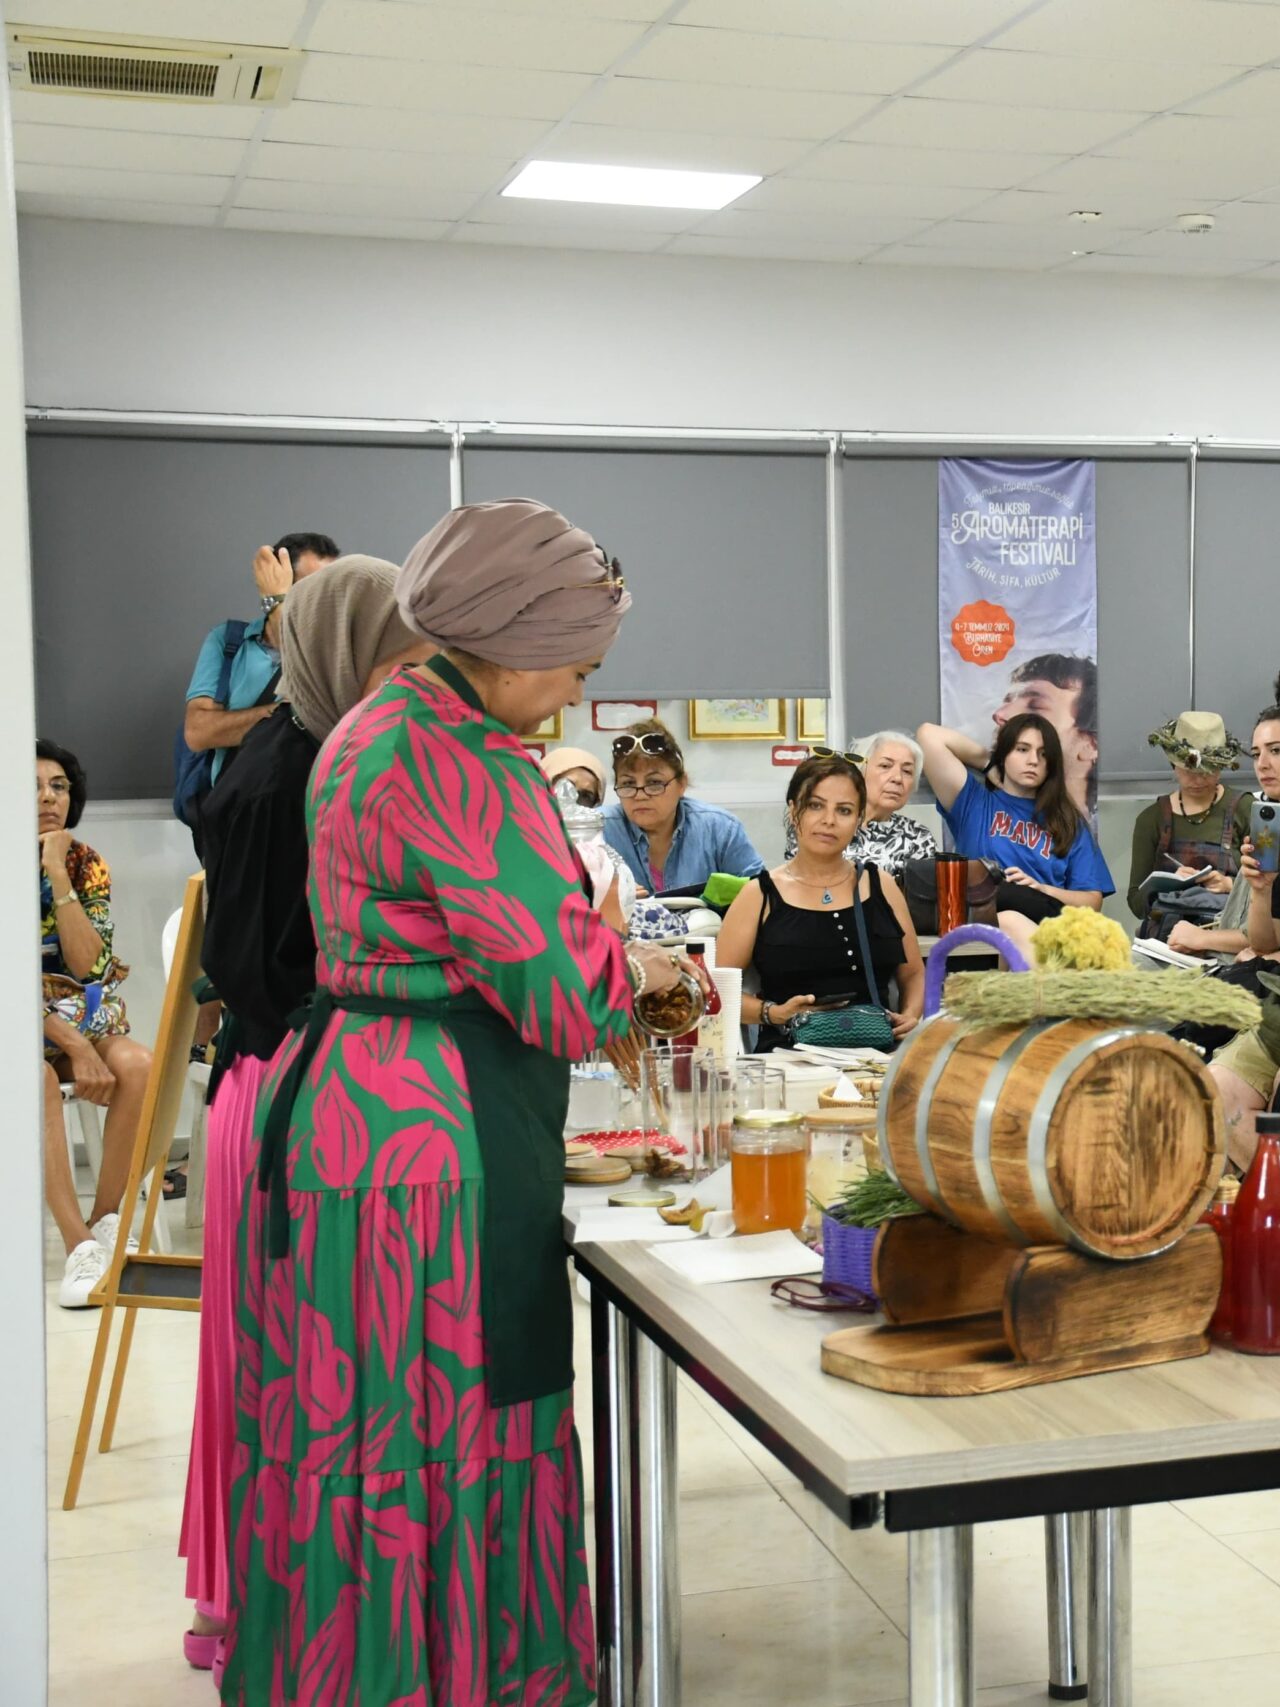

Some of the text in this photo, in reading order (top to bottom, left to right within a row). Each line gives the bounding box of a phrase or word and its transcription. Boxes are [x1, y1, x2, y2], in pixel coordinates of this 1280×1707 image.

[989, 501, 1031, 515] BALIKESİR
[951, 510, 1083, 544] AROMATERAPİ
[1001, 539, 1076, 566] FESTİVALİ
